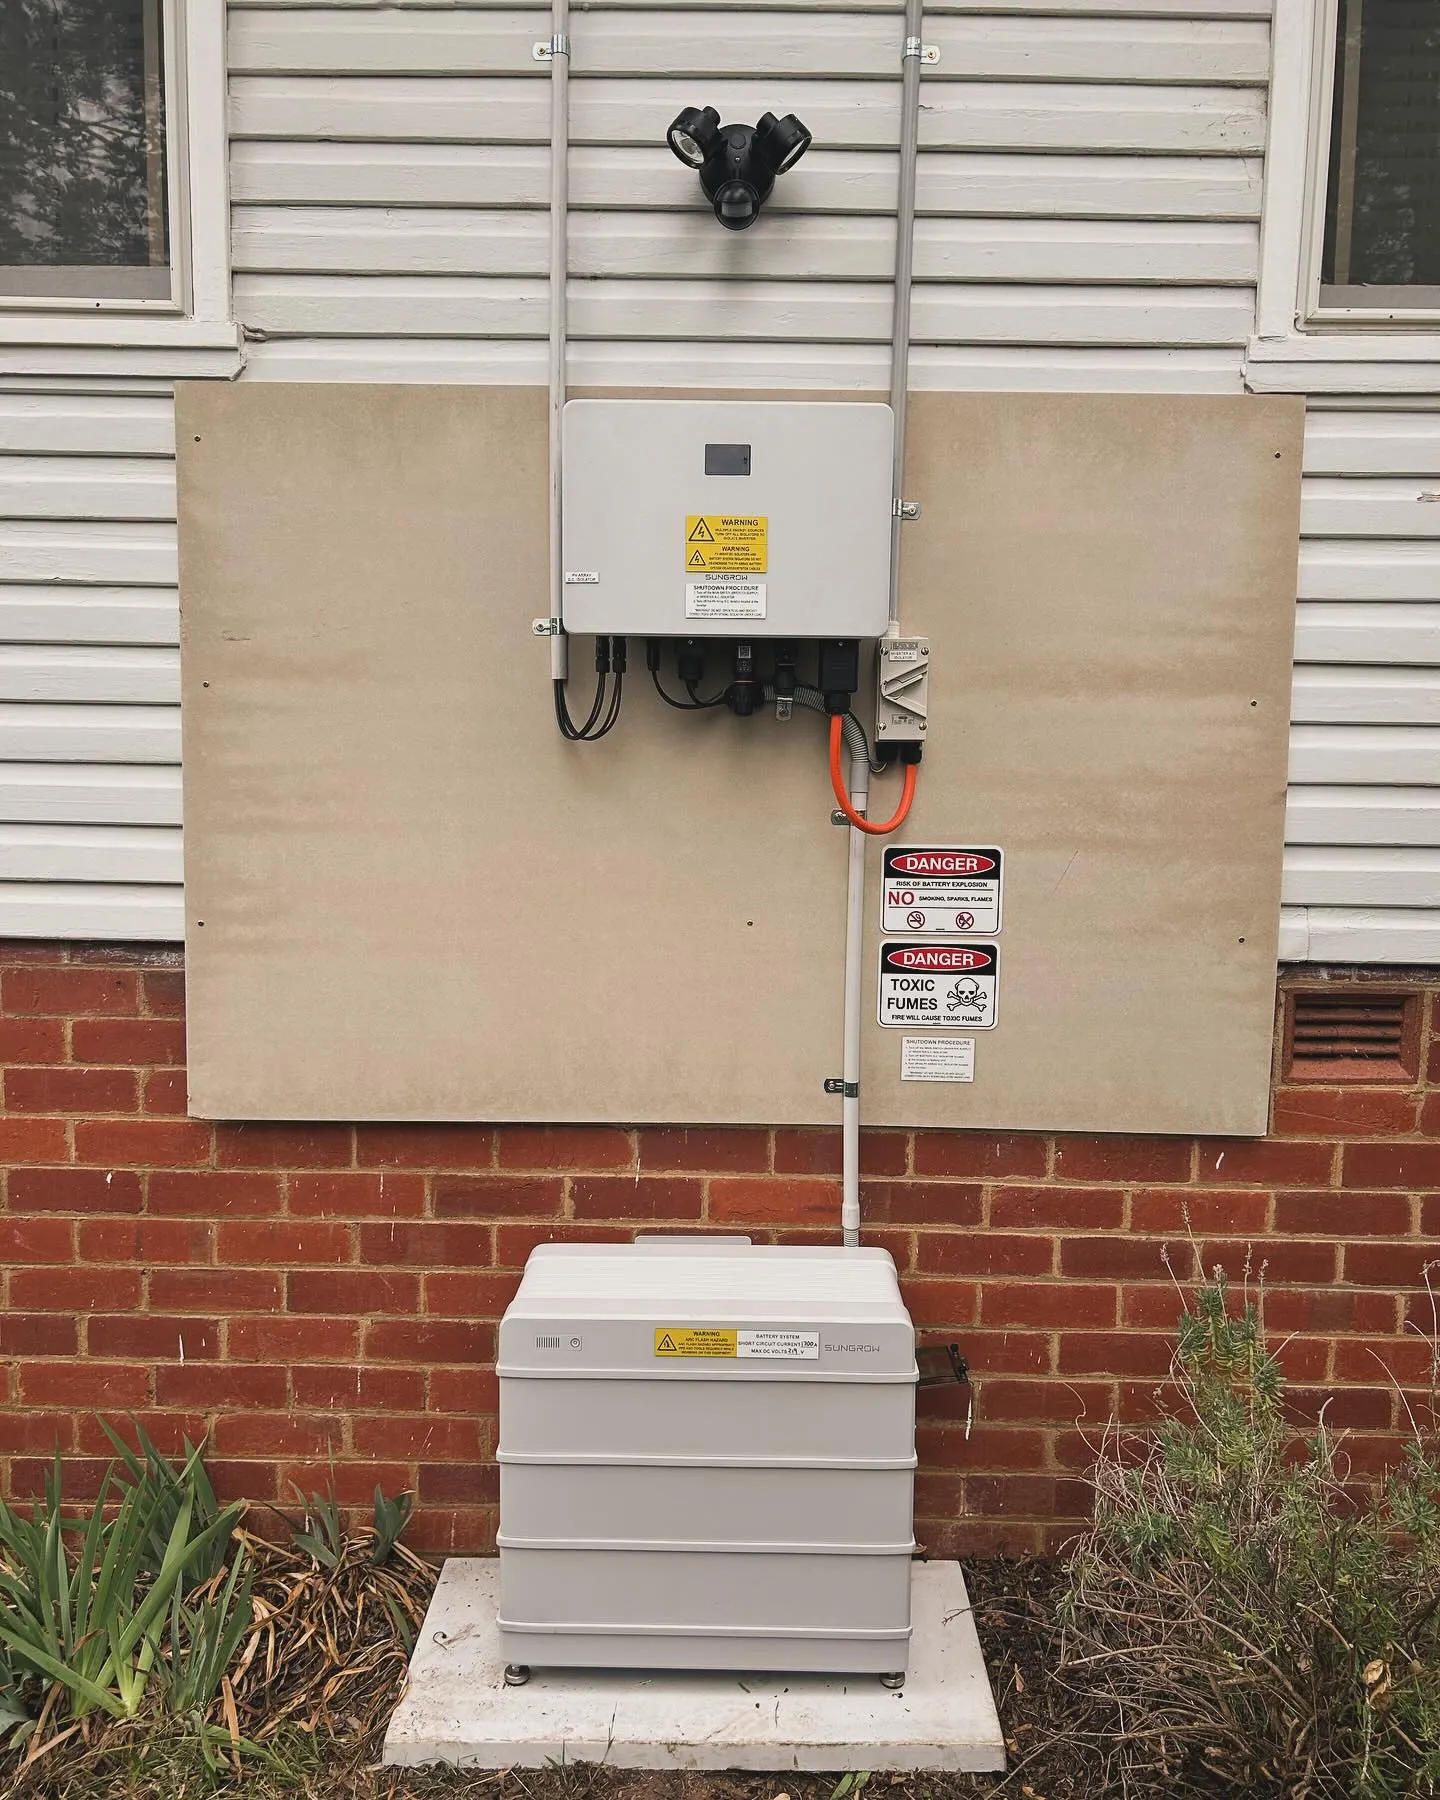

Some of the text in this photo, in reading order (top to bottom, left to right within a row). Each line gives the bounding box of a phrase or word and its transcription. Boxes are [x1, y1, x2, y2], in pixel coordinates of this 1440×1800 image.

[906, 857, 978, 871] DANGER
[888, 891, 915, 905] NO
[903, 952, 974, 966] DANGER
[891, 978, 935, 992] TOXIC
[887, 998, 938, 1010] FUMES
